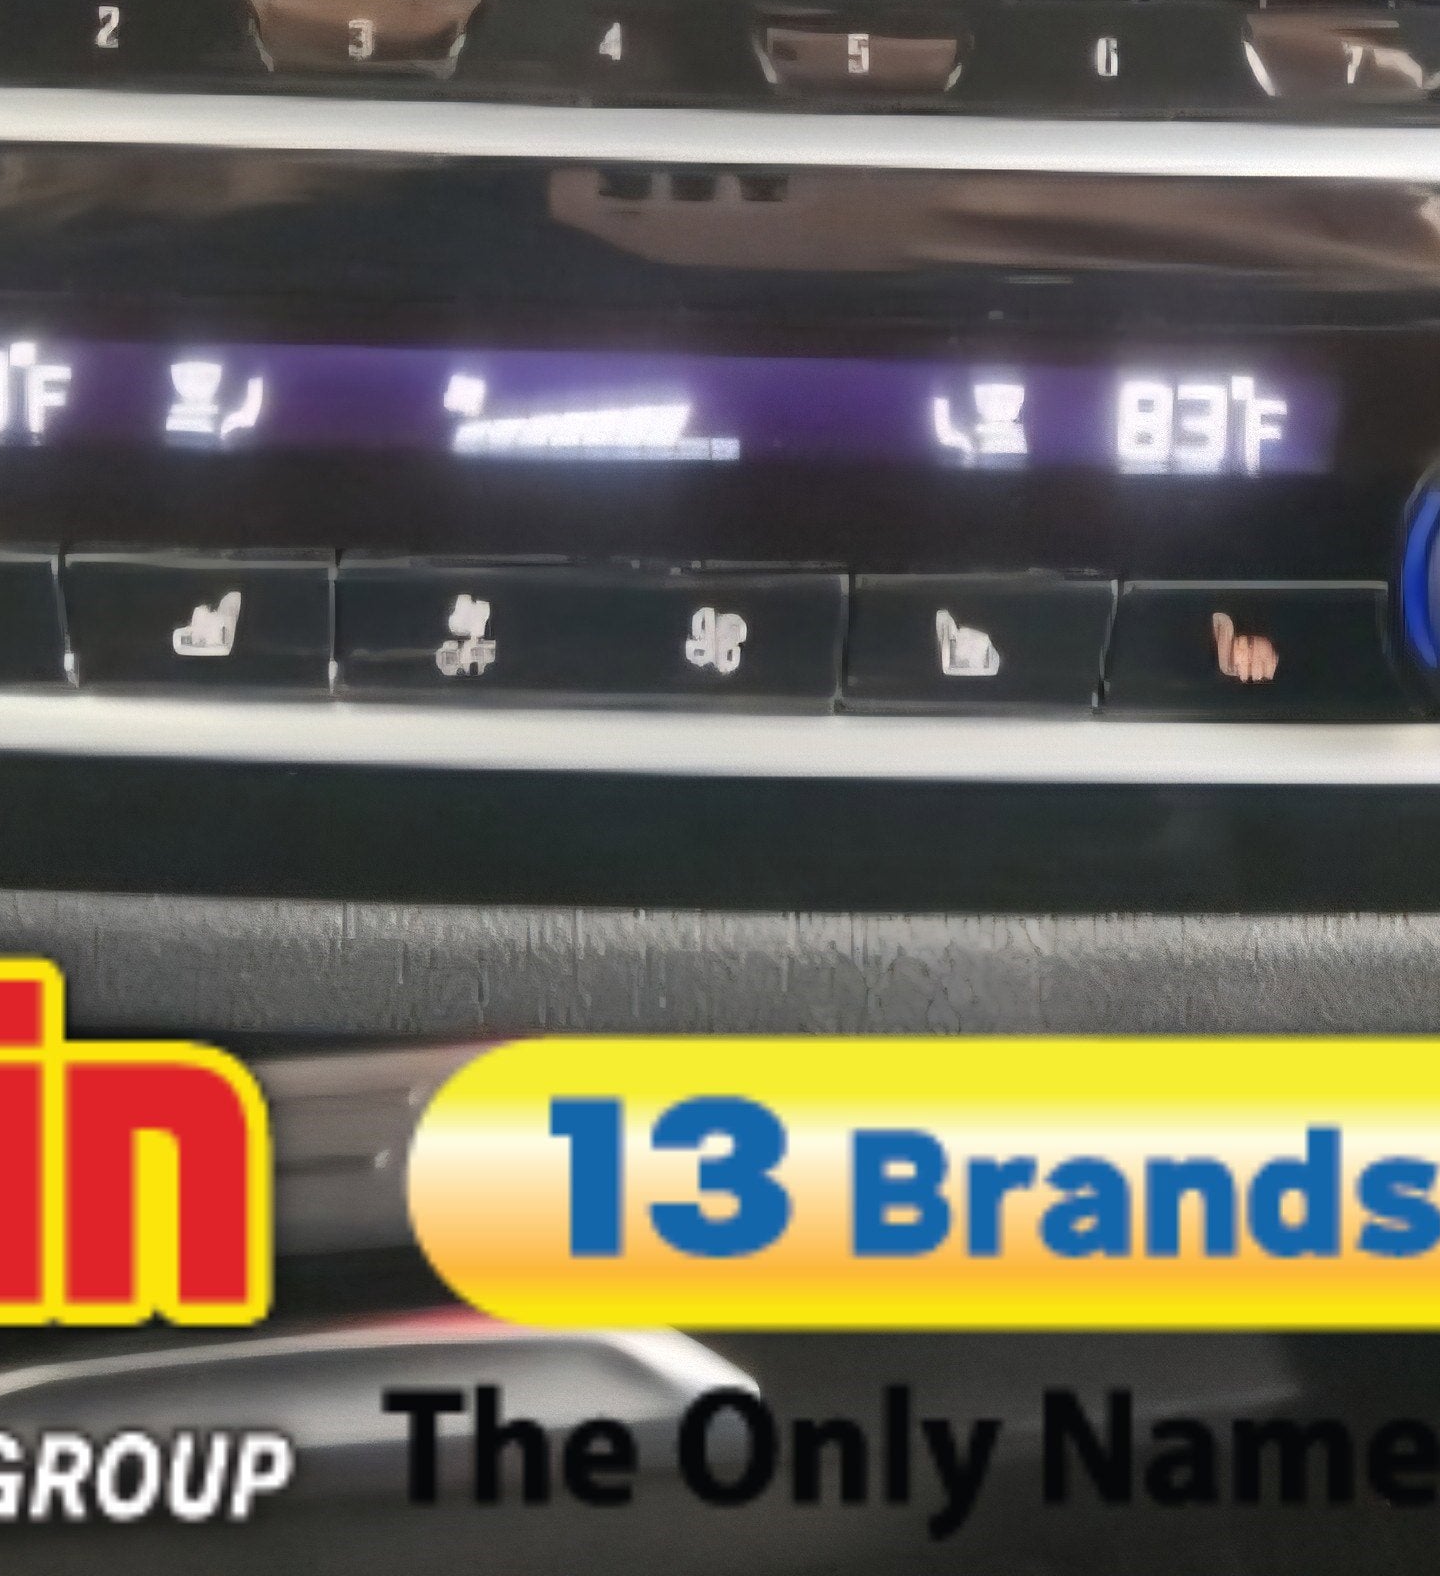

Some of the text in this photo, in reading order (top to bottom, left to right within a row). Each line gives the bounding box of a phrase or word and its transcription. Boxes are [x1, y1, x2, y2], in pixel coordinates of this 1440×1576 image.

[97, 5, 120, 48] 2
[348, 18, 374, 59] 3
[598, 21, 622, 61] 4
[846, 32, 870, 74] 5
[1096, 36, 1119, 77] 6
